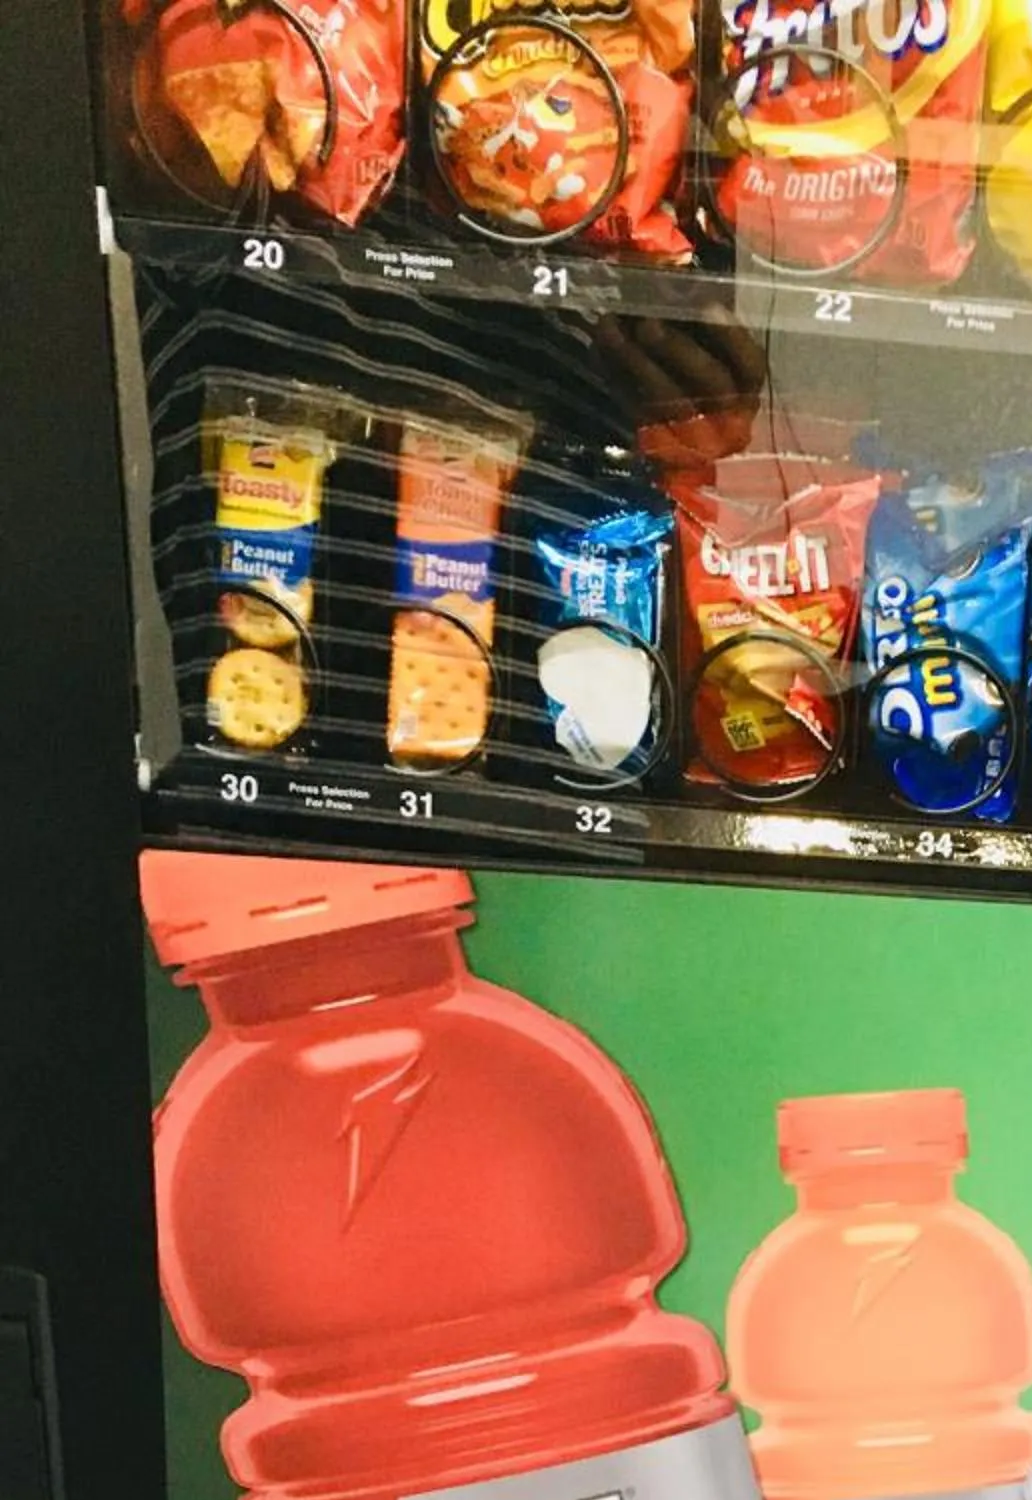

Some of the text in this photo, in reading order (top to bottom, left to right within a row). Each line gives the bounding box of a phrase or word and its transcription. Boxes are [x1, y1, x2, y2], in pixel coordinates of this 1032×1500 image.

[243, 240, 284, 270] 20
[532, 265, 568, 297] 21
[814, 292, 852, 323] 22
[232, 538, 294, 565] Peanut
[424, 553, 488, 579] Peanut
[424, 569, 481, 593] Butter
[220, 773, 259, 803] 30
[399, 790, 434, 819] 31
[575, 806, 613, 834] 32
[916, 832, 953, 859] 34
